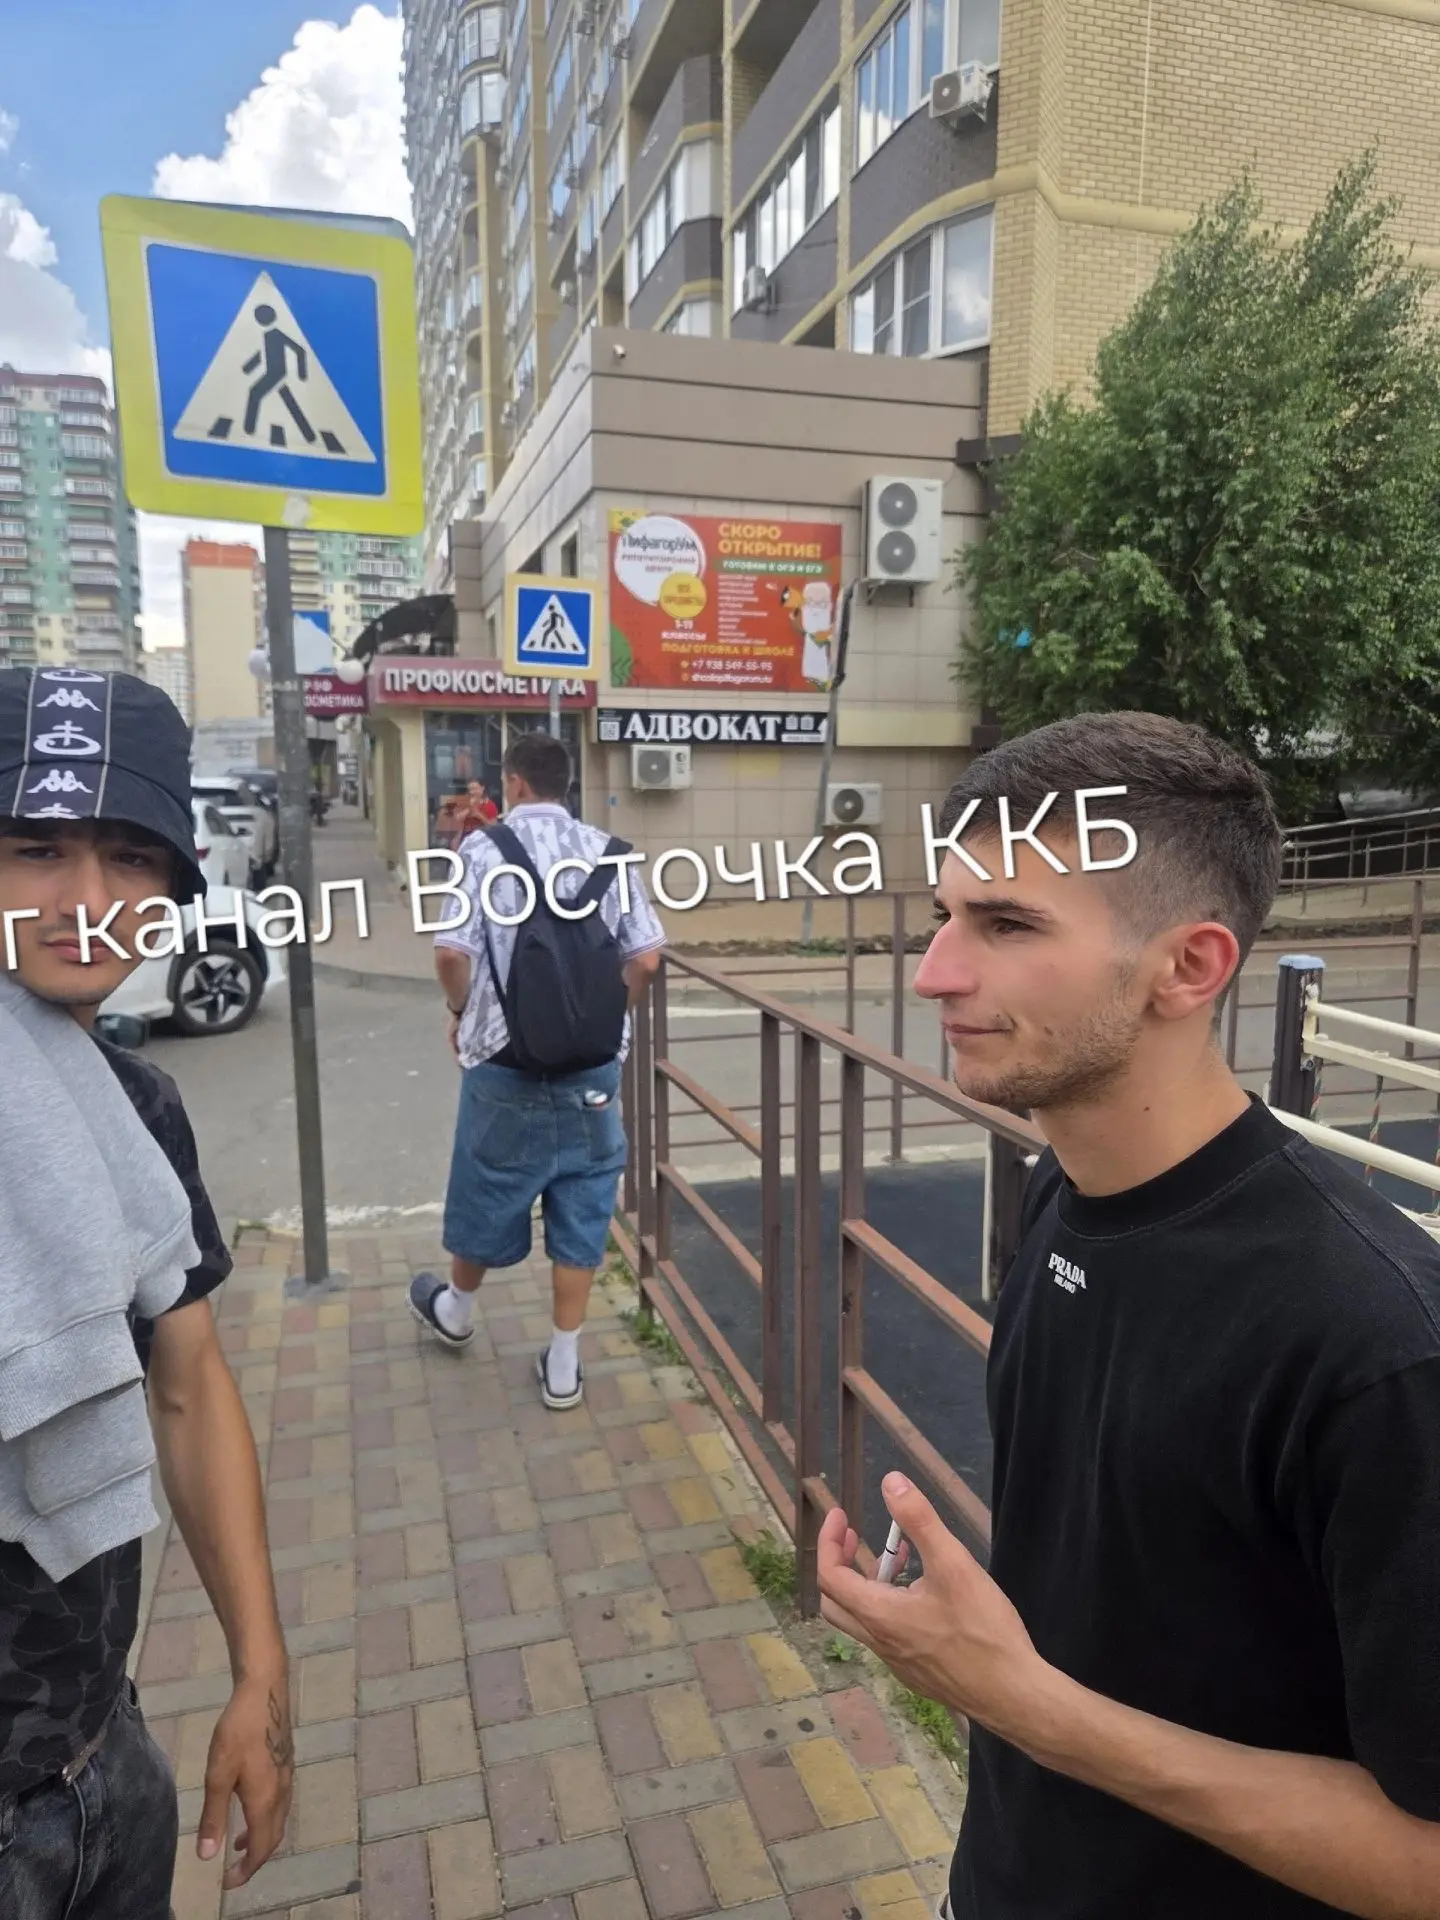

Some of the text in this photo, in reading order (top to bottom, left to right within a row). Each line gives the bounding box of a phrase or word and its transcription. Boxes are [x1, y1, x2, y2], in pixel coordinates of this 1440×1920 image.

[718, 522, 781, 540] СКОРО
[718, 540, 822, 557] ОТКРЫТИЕ!
[722, 560, 768, 571] ГОТОВИМ
[776, 563, 796, 573] ОГЭ
[805, 564, 823, 574] ЕГЭ
[661, 642, 741, 654] ПОДГОТОВКА
[753, 645, 795, 656] ШКОЛЕ
[624, 712, 782, 742] АДВОКАТ
[1048, 1252, 1087, 1289] PRADA
